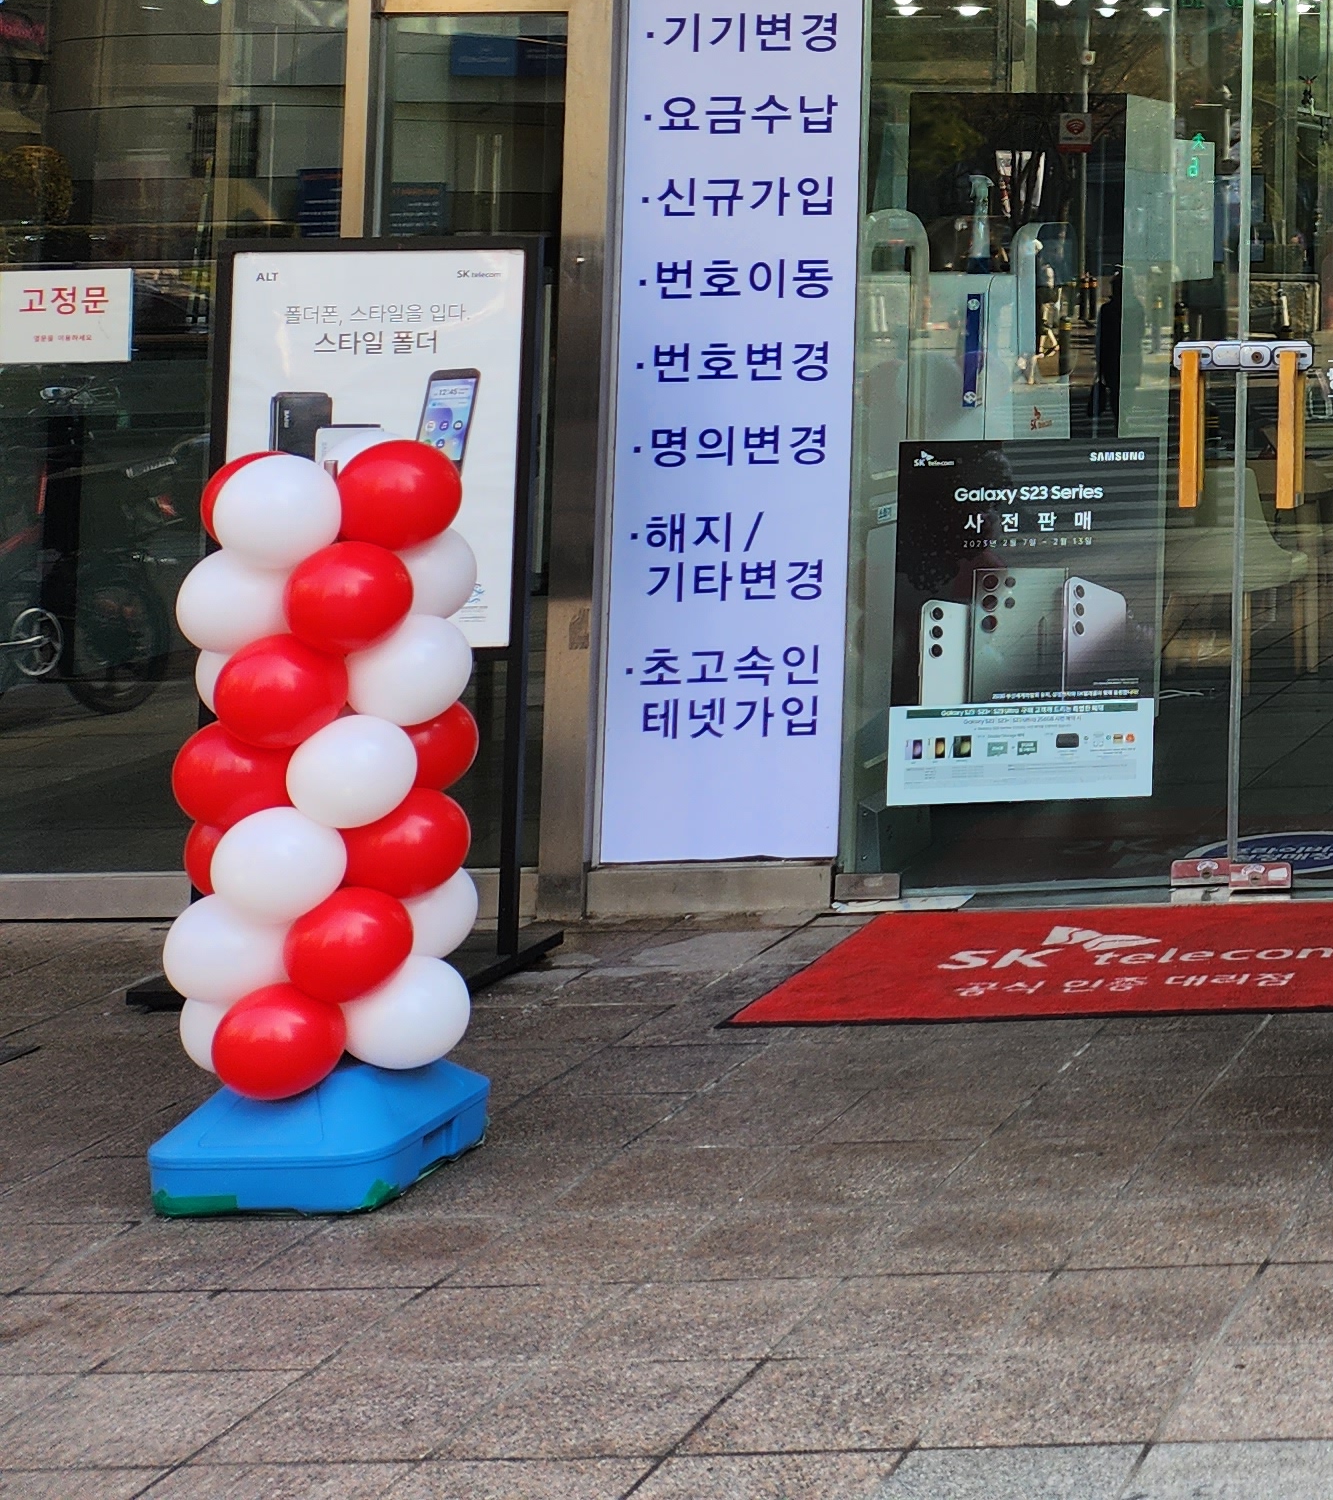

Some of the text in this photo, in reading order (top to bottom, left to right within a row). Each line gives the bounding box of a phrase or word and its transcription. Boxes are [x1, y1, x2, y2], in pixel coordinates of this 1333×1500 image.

[255, 272, 279, 282] ALT
[456, 269, 470, 279] SK
[19, 286, 109, 315] 고정문
[350, 303, 424, 323] 스타일을
[313, 329, 438, 355] 스타일 폴더
[1089, 451, 1145, 462] SAMSUNG
[954, 484, 1104, 505] Galaxy S23 Series
[646, 559, 824, 602] 기타변경
[642, 695, 819, 739] 테넷가입
[937, 948, 1064, 970] SK
[954, 970, 1296, 999] 공식 인증 대리점
